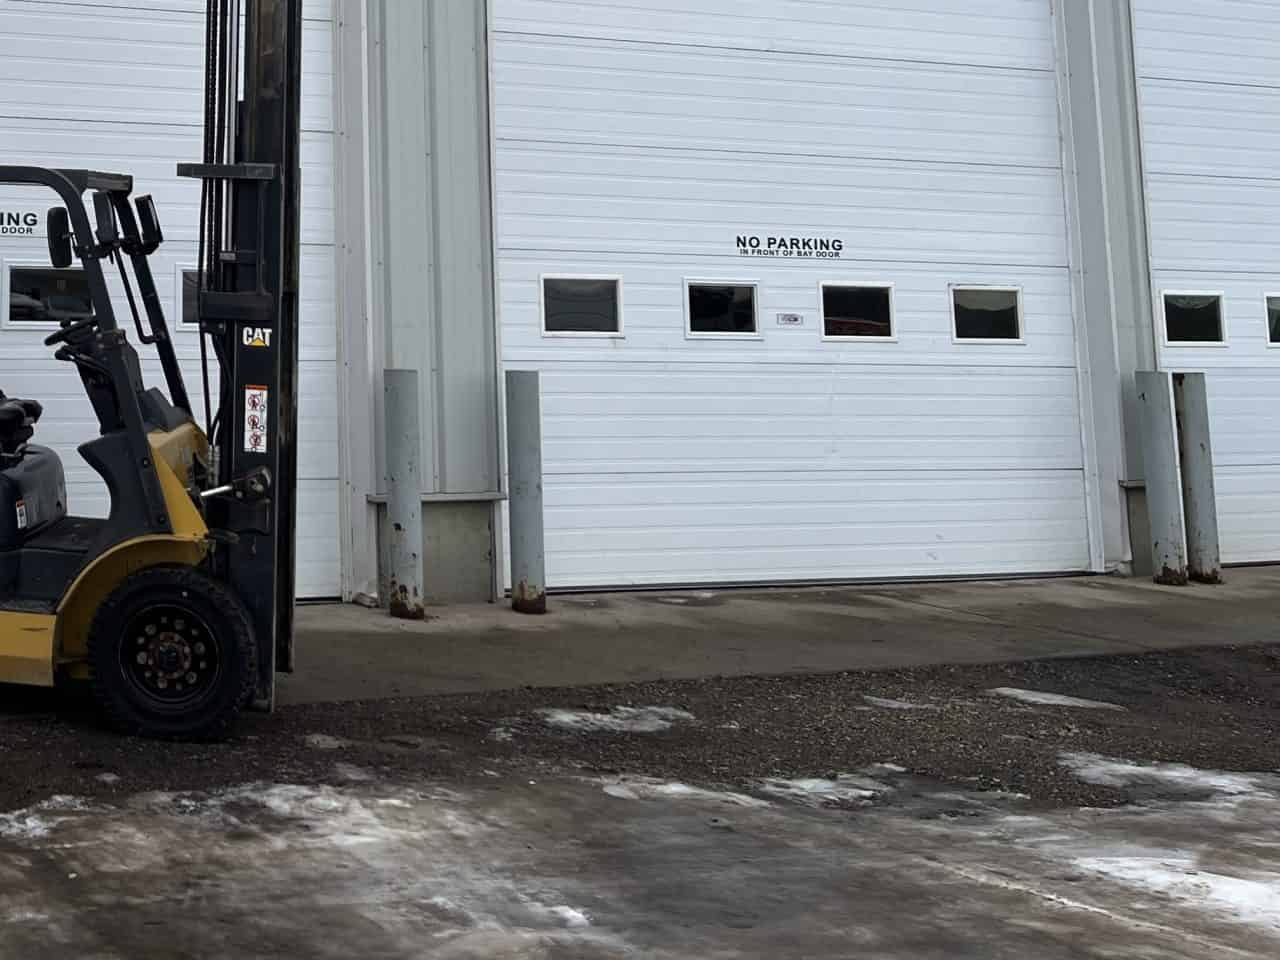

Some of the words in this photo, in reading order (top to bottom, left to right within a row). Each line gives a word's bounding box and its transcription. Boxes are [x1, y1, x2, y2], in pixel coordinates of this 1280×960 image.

[1, 226, 33, 234] DOOR
[736, 235, 760, 248] NO
[767, 237, 843, 251] PARKING
[815, 250, 841, 258] DOOR
[242, 326, 272, 347] CAT
